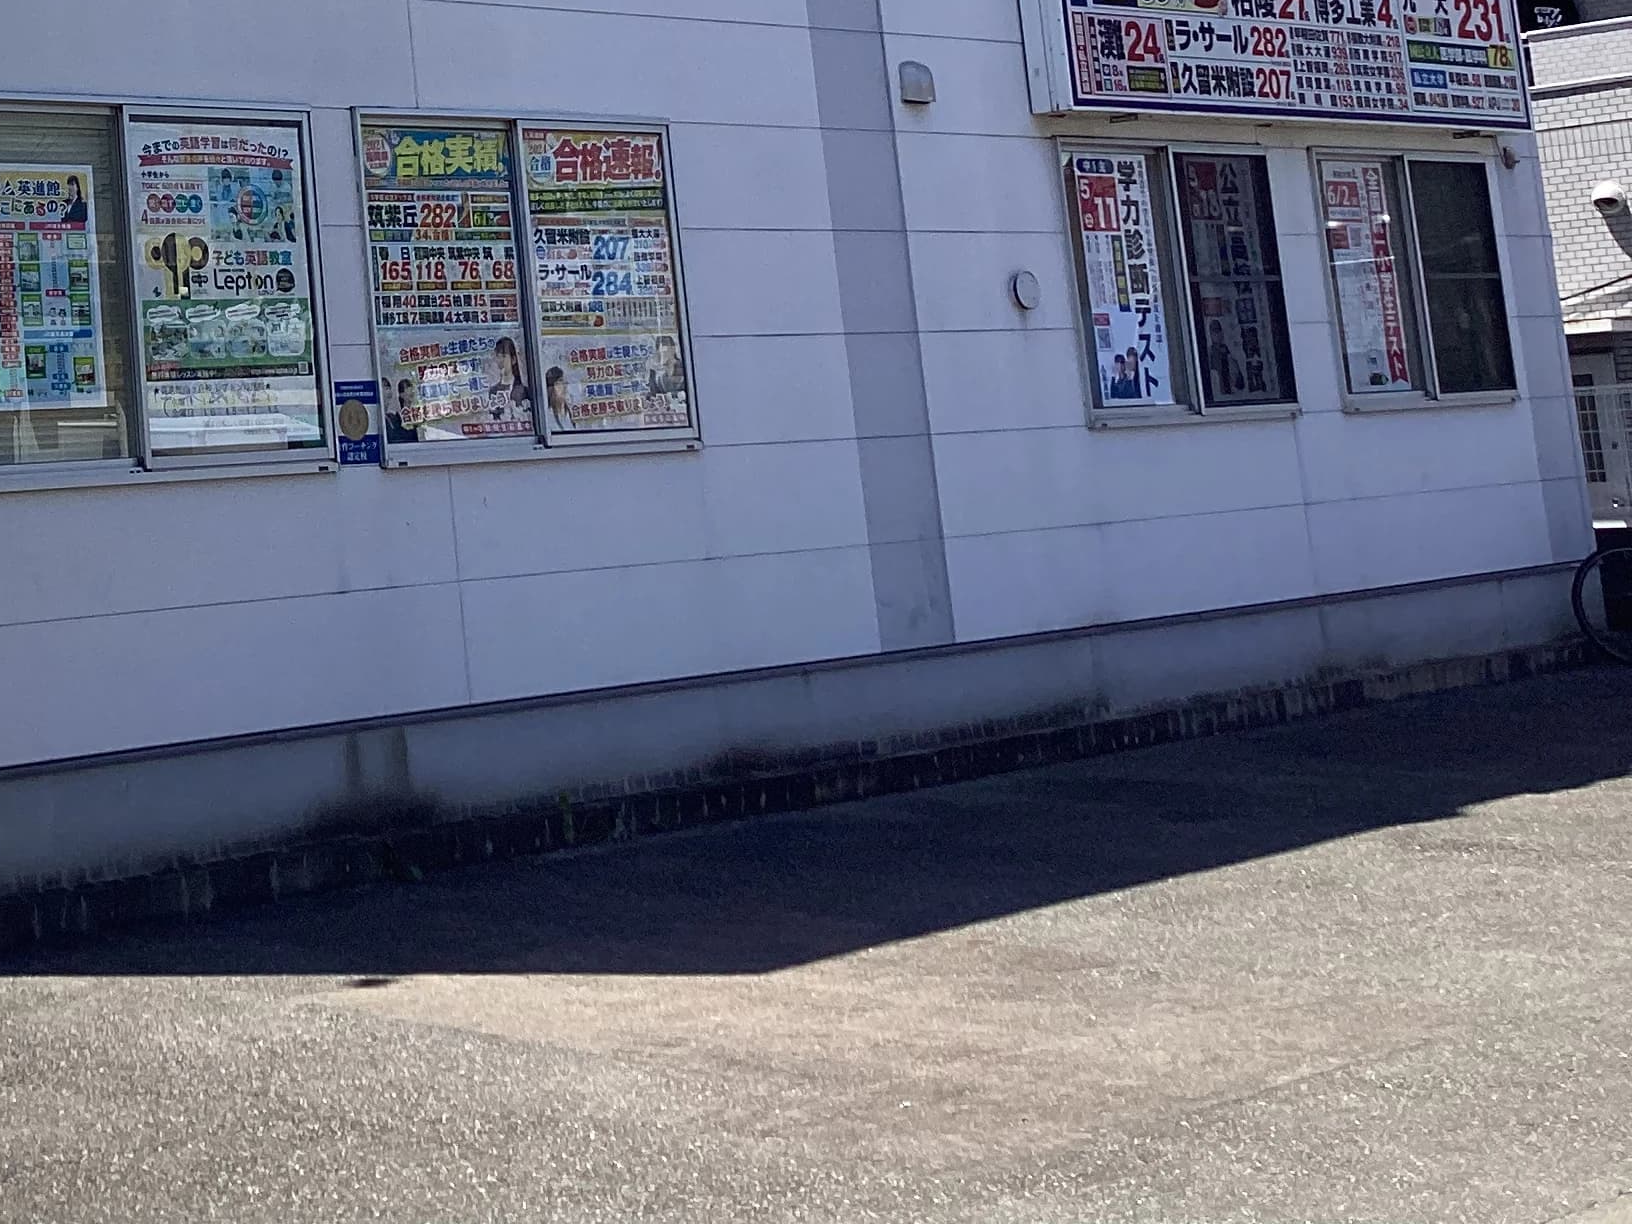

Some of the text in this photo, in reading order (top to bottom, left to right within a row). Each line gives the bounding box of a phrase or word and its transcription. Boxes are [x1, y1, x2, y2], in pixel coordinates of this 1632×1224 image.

[553, 136, 662, 183] 合格速報!
[18, 180, 60, 196] 英進館
[212, 250, 293, 265] 子ども英語教室
